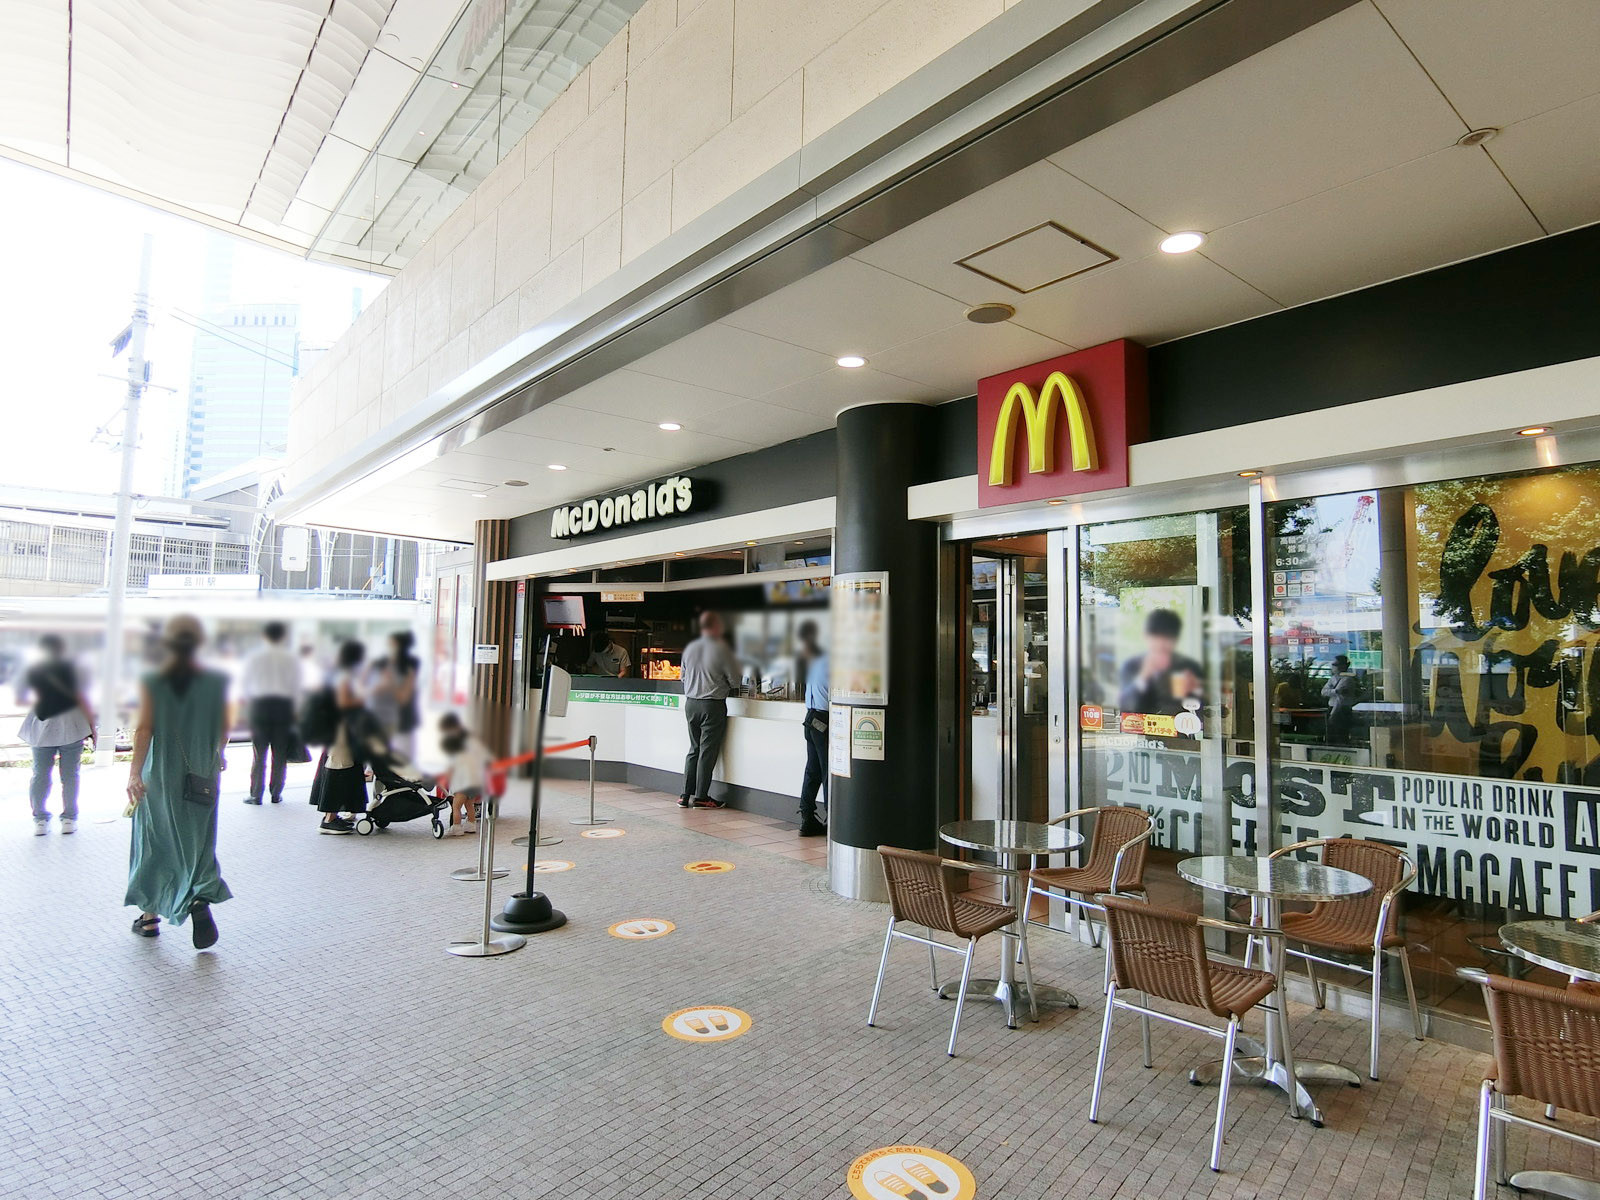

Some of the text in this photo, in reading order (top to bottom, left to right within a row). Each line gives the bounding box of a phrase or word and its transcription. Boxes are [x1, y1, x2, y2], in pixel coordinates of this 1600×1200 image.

[551, 476, 693, 538] McDonald's
[1402, 776, 1484, 811] POPULAR
[1492, 784, 1555, 818] DRINK
[1392, 805, 1555, 849] IN THE WORLD
